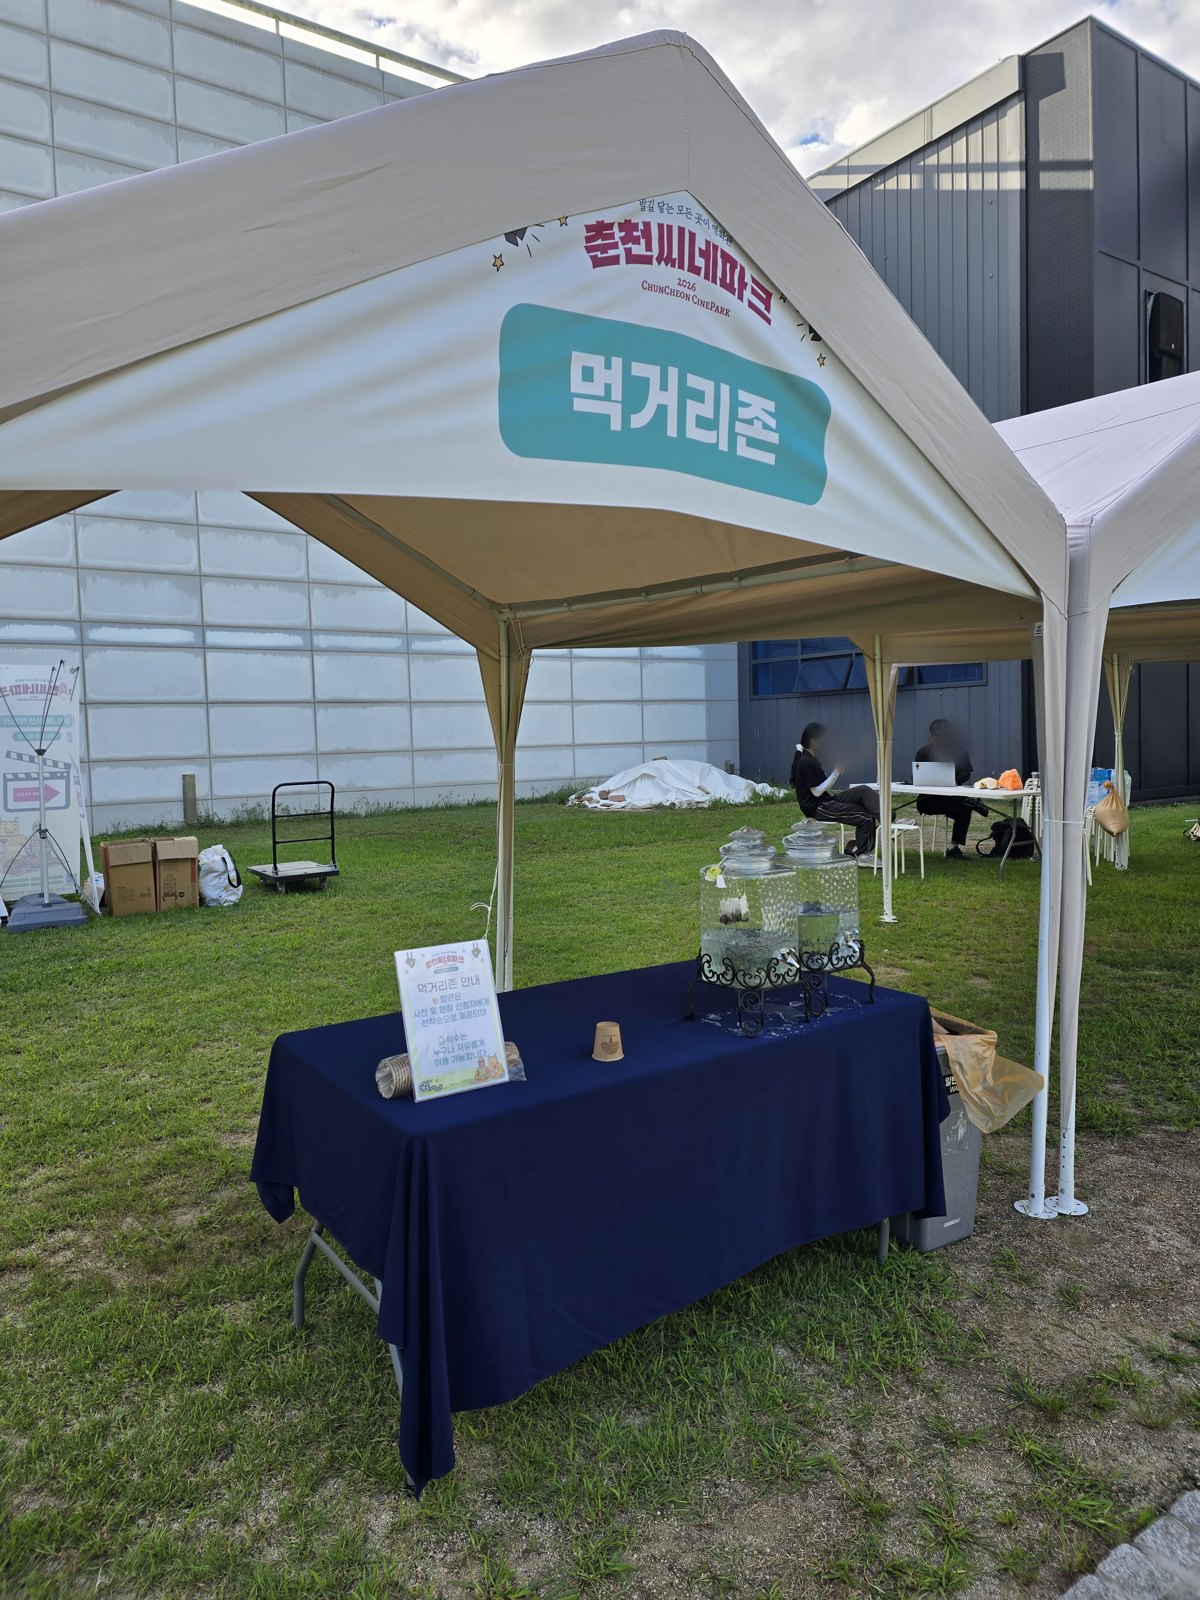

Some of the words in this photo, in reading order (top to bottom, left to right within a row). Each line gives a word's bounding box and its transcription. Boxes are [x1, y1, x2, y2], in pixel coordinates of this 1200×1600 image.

[639, 198, 655, 213] 발길
[657, 200, 675, 215] 닿는
[676, 205, 693, 220] 모든
[694, 212, 710, 230] 곳이
[583, 218, 774, 326] 춘천씨네파크
[677, 277, 697, 292] 2026
[570, 350, 780, 466] 먹거리존
[417, 978, 458, 994] 먹거리존
[460, 974, 481, 988] 안내
